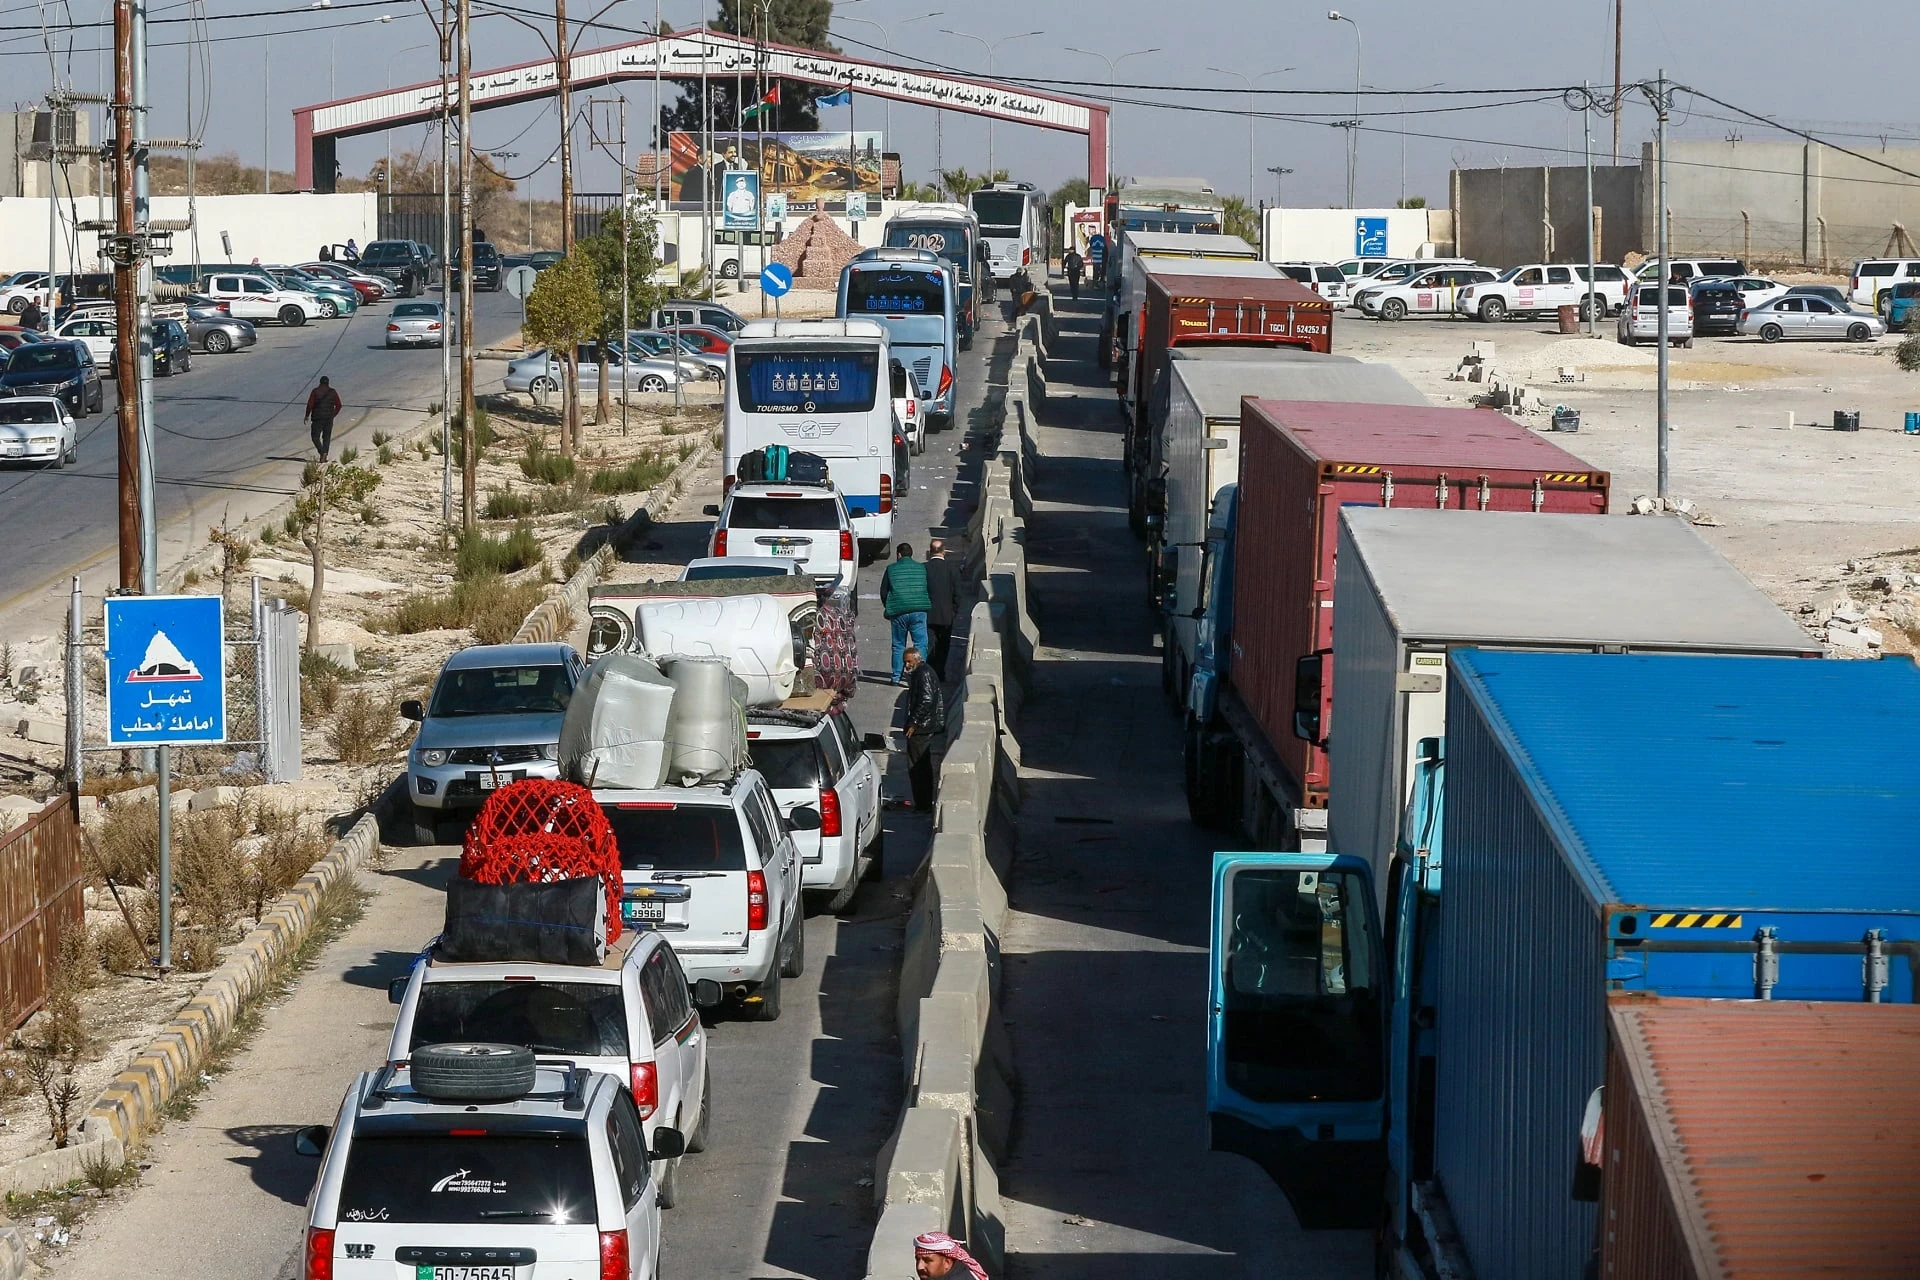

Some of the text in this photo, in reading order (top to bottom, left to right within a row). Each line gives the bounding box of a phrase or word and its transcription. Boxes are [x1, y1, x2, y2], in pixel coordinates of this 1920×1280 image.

[725, 52, 771, 69] الوطن
[468, 78, 520, 91] حدود
[793, 57, 1045, 116] المملكة الأردنية الهاشمية تستودعكم السلامة
[908, 234, 946, 252] 2024
[1296, 324, 1320, 334] 524252
[756, 405, 799, 413] TOURISMO
[140, 689, 192, 708] تمهل
[641, 900, 653, 909] 50
[632, 910, 662, 918] 39968
